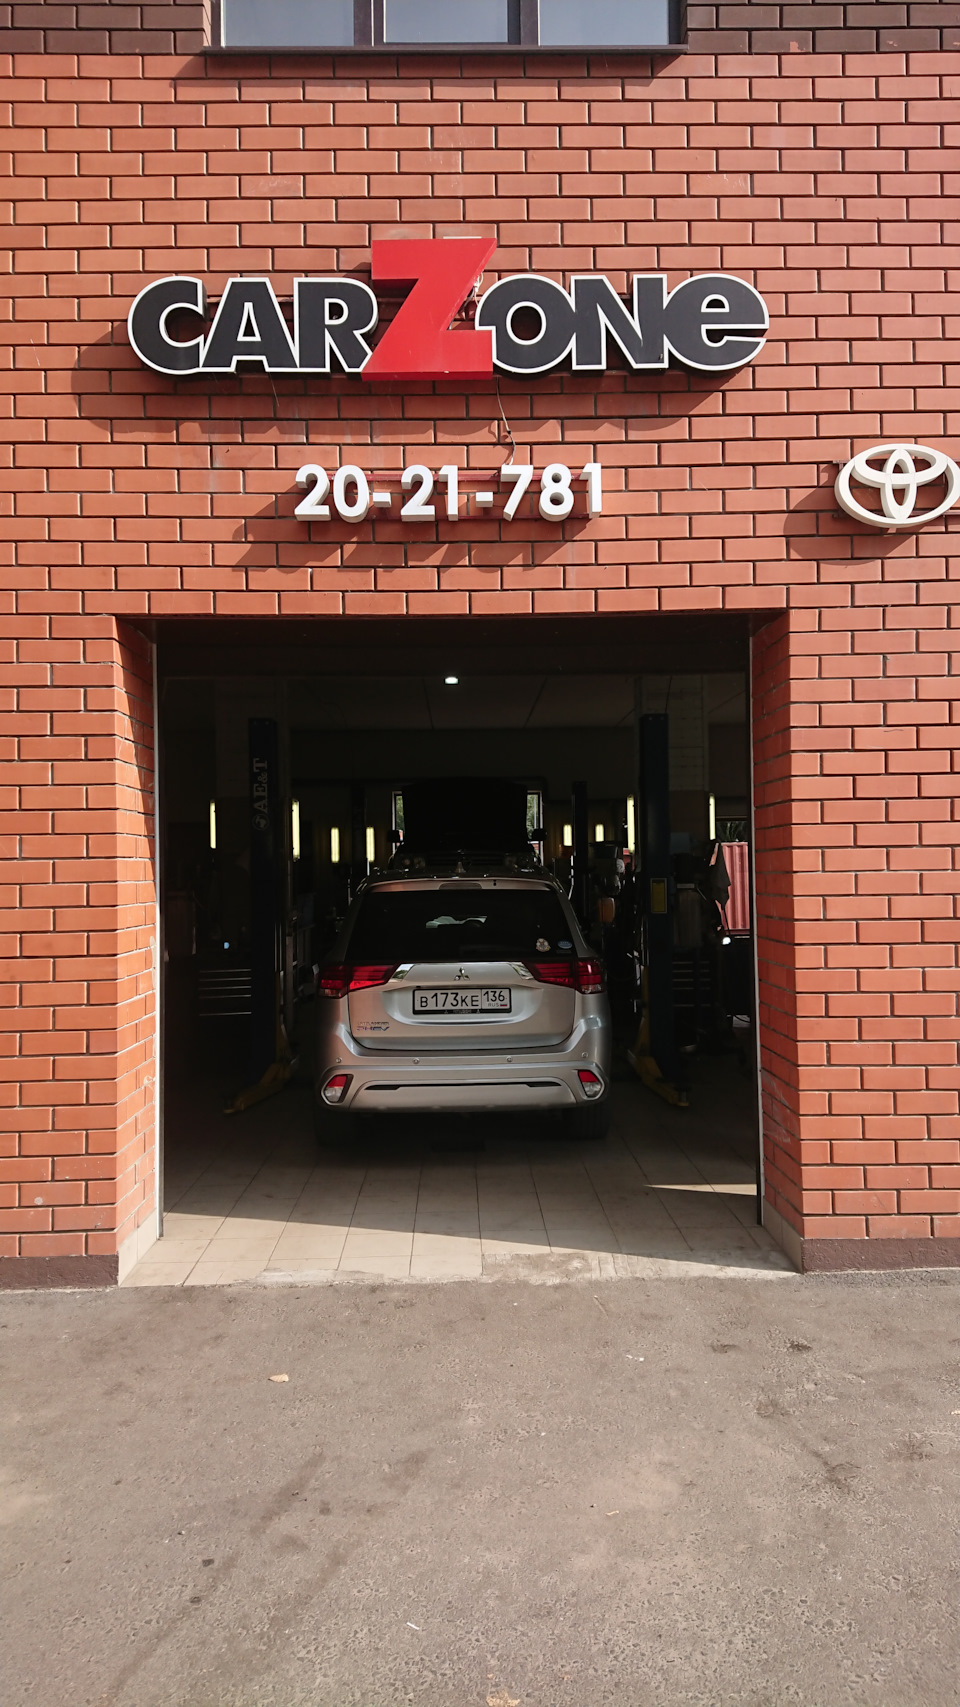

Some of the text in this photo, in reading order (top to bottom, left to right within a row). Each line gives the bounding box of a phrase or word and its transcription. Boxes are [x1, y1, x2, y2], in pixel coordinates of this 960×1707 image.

[296, 463, 602, 522] 20-21-781
[253, 757, 268, 813] AE&T
[483, 990, 505, 1002] 136
